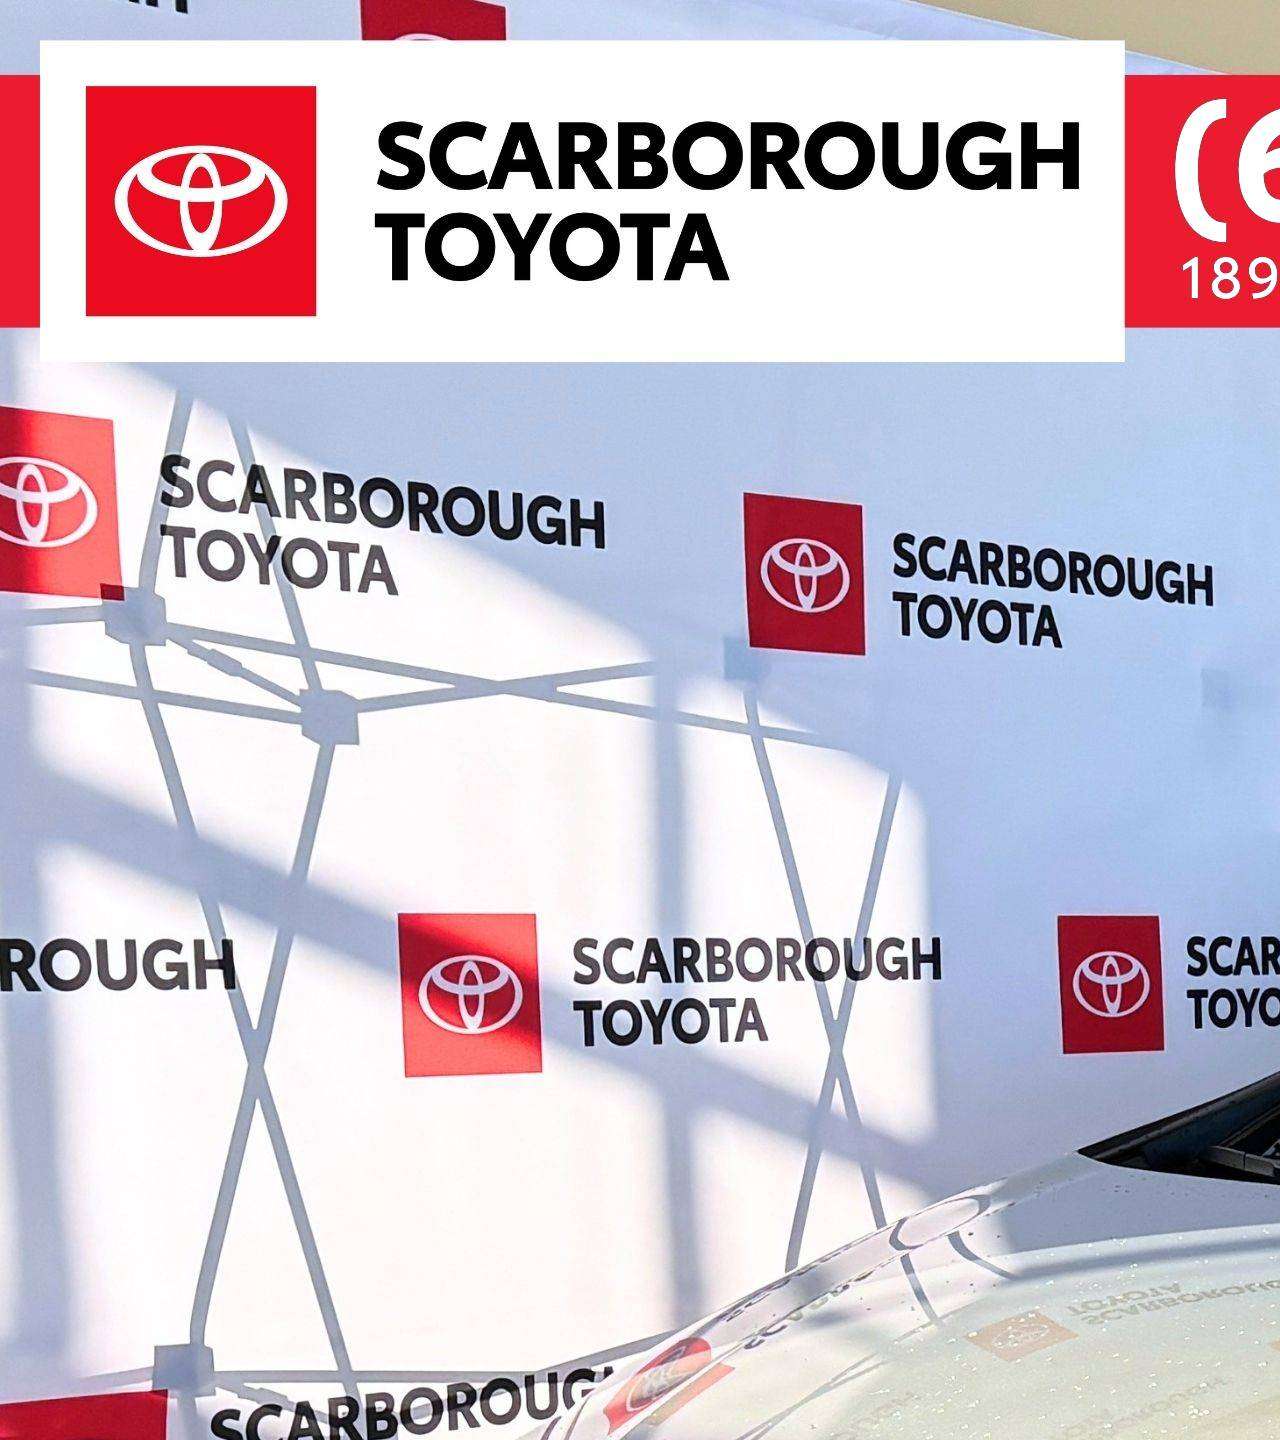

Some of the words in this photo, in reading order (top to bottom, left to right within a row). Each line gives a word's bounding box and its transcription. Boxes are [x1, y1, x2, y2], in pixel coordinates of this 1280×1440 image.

[159, 454, 606, 549] SCARBOROUGH
[159, 523, 399, 596] TOYOTA
[892, 531, 1214, 607] SCARBOROUGH
[892, 590, 1063, 650] TOYOTA
[573, 936, 942, 985] SCARBOROUGH
[573, 996, 769, 1048] TOYOTA
